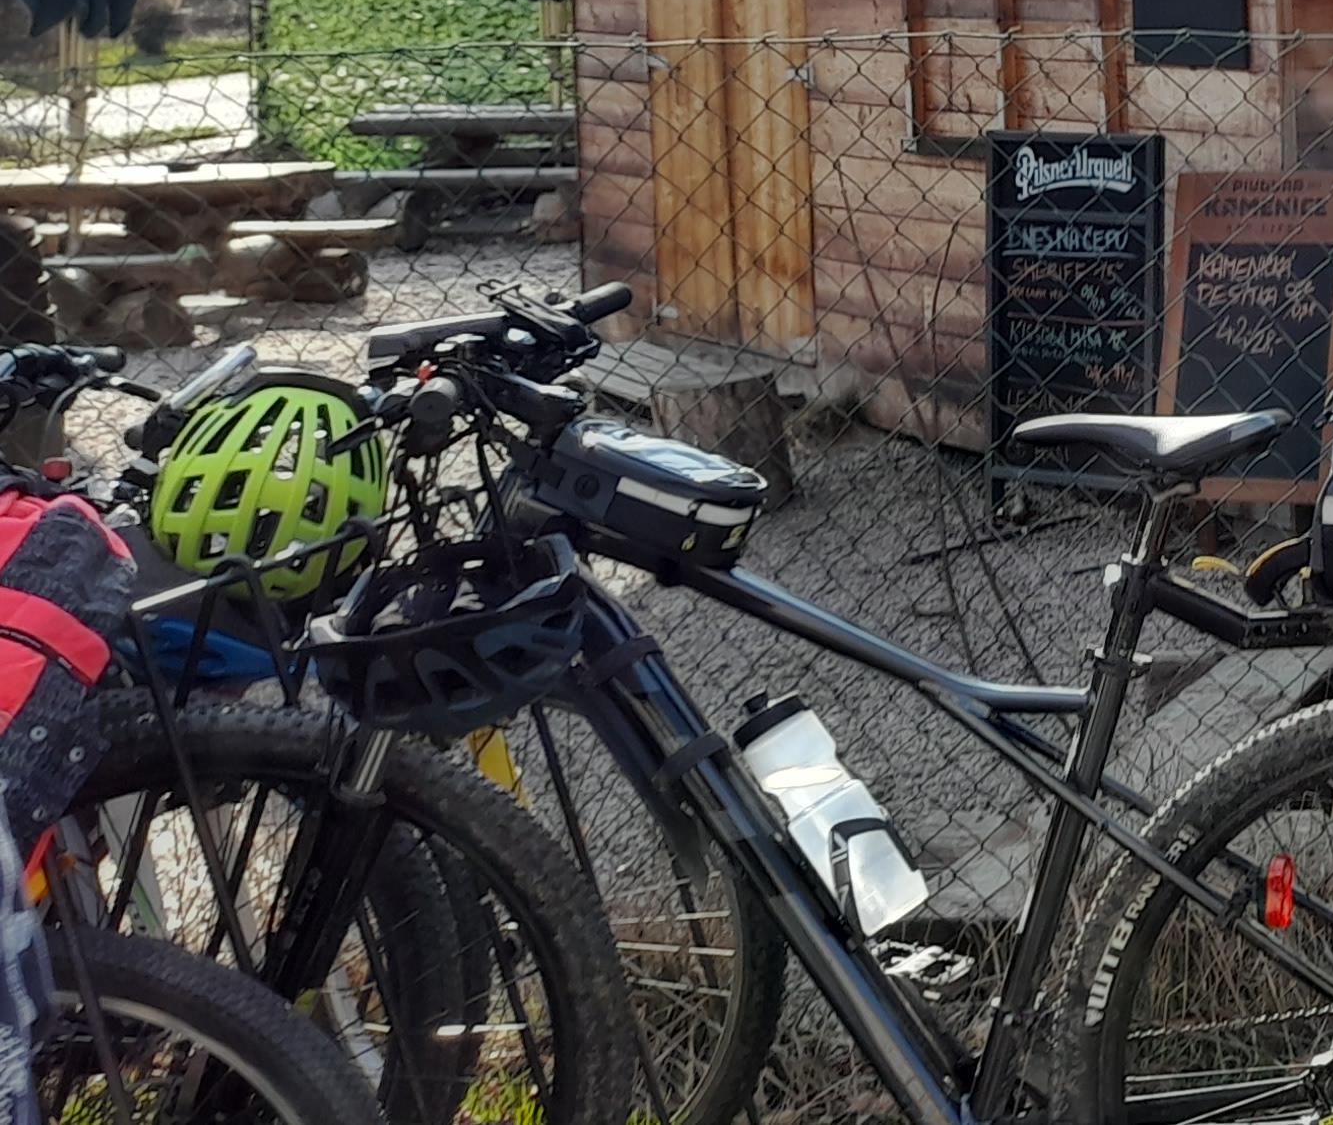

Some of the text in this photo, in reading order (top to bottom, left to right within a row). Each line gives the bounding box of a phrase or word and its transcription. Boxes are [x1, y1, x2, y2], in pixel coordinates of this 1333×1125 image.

[1015, 145, 1134, 202] Pilsner Urquell
[1125, 838, 1188, 922] RANER
